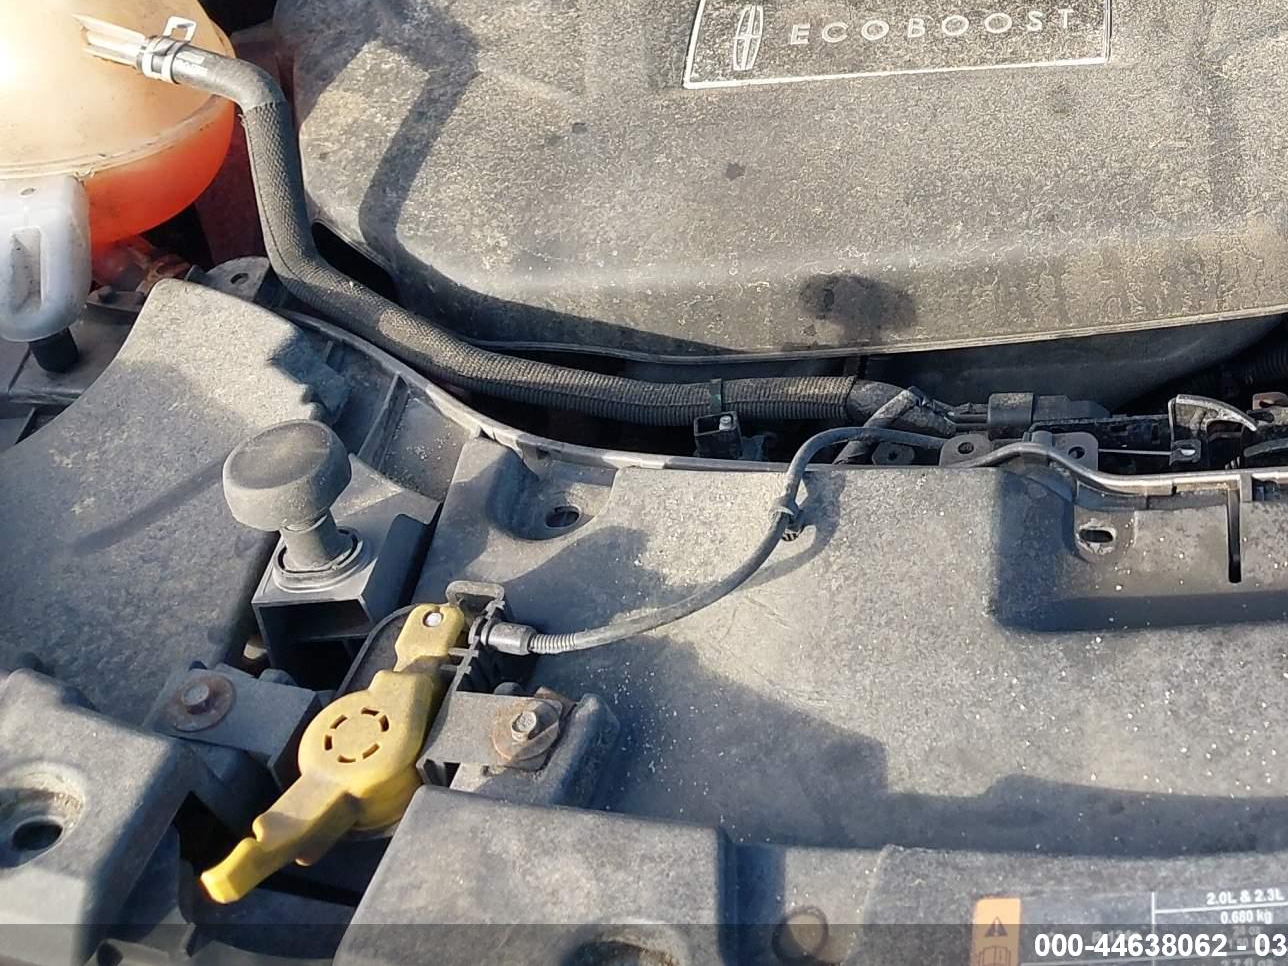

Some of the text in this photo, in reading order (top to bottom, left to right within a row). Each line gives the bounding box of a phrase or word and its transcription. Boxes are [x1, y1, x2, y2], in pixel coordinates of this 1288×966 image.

[790, 8, 1074, 45] ECOBOOST
[1206, 888, 1285, 905] 2.0L & 2.3L
[1220, 909, 1273, 924] 0.680 kg
